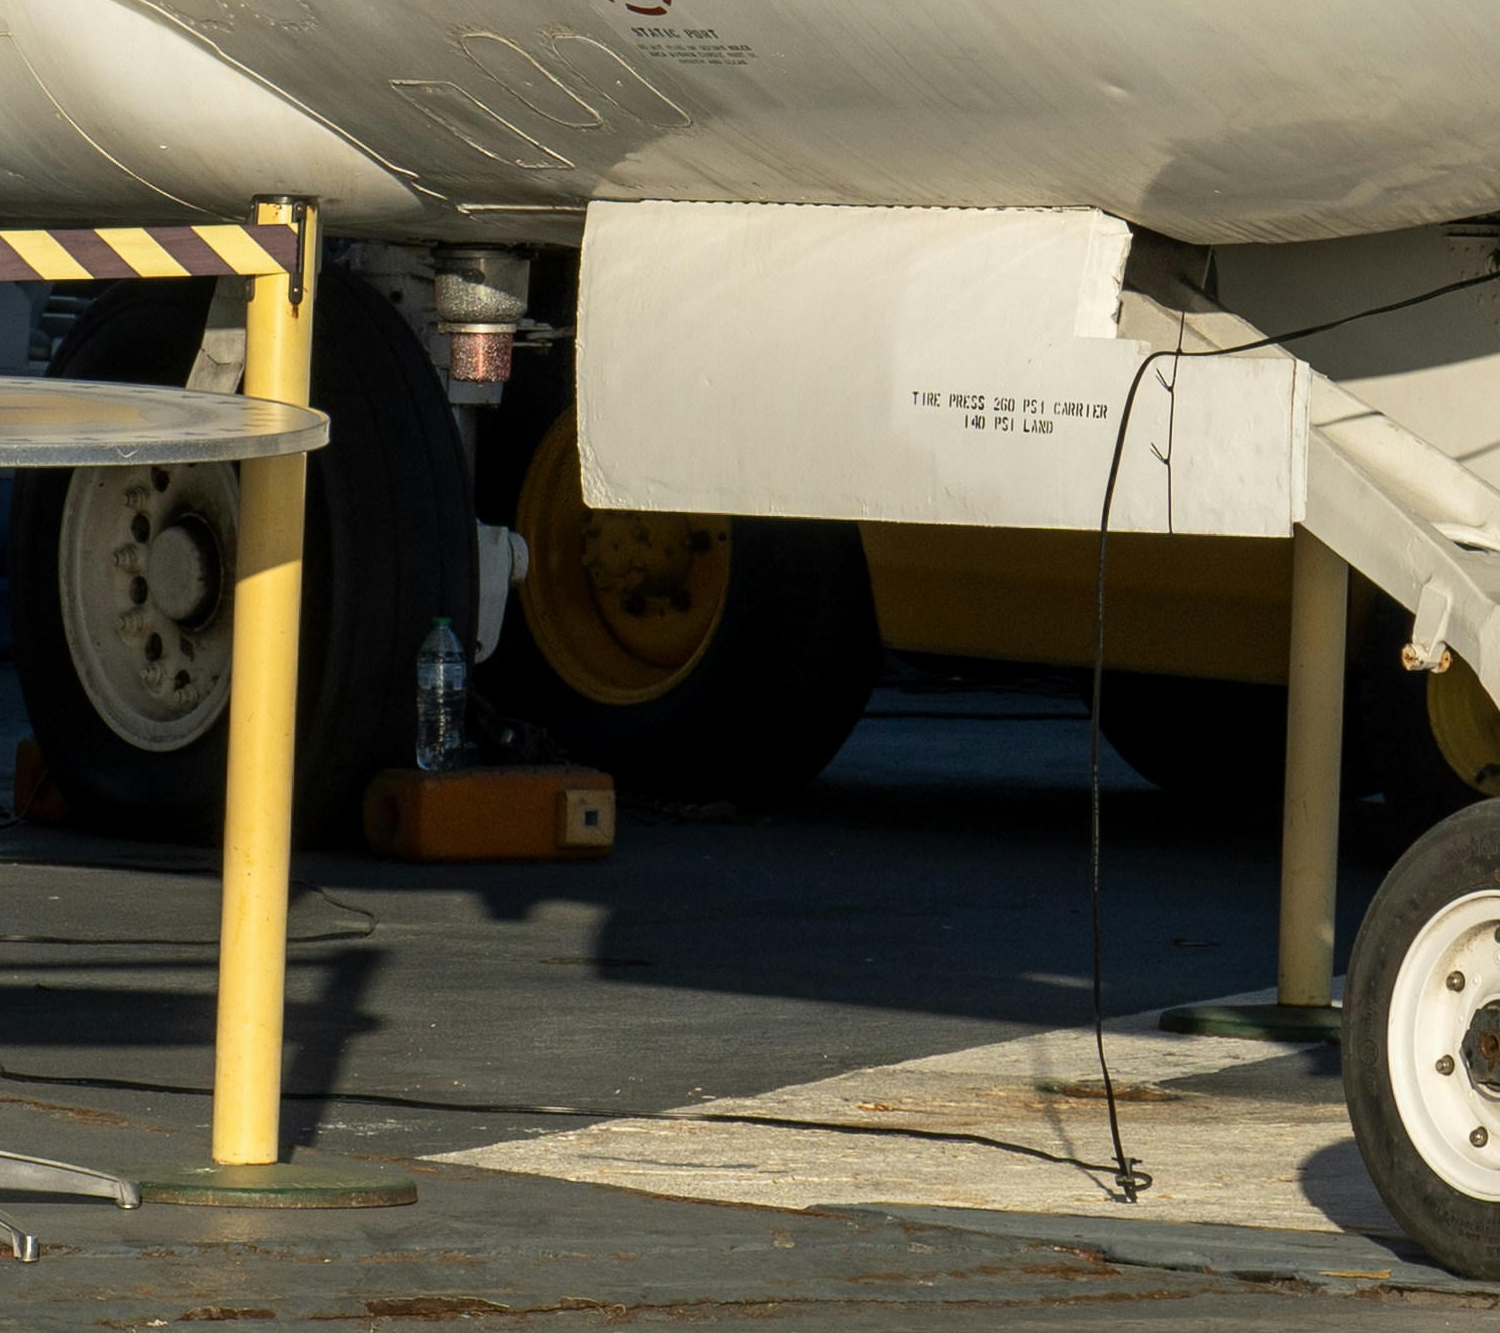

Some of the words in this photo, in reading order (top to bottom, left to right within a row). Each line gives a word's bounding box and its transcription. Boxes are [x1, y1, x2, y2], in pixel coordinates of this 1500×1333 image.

[912, 391, 941, 408] TIRE
[949, 393, 985, 411] PRESS
[1023, 398, 1045, 415] PSI
[1054, 401, 1108, 419] CARRIER
[964, 414, 986, 430] 140
[994, 416, 1014, 432] PSI
[1023, 418, 1054, 435] LAND
